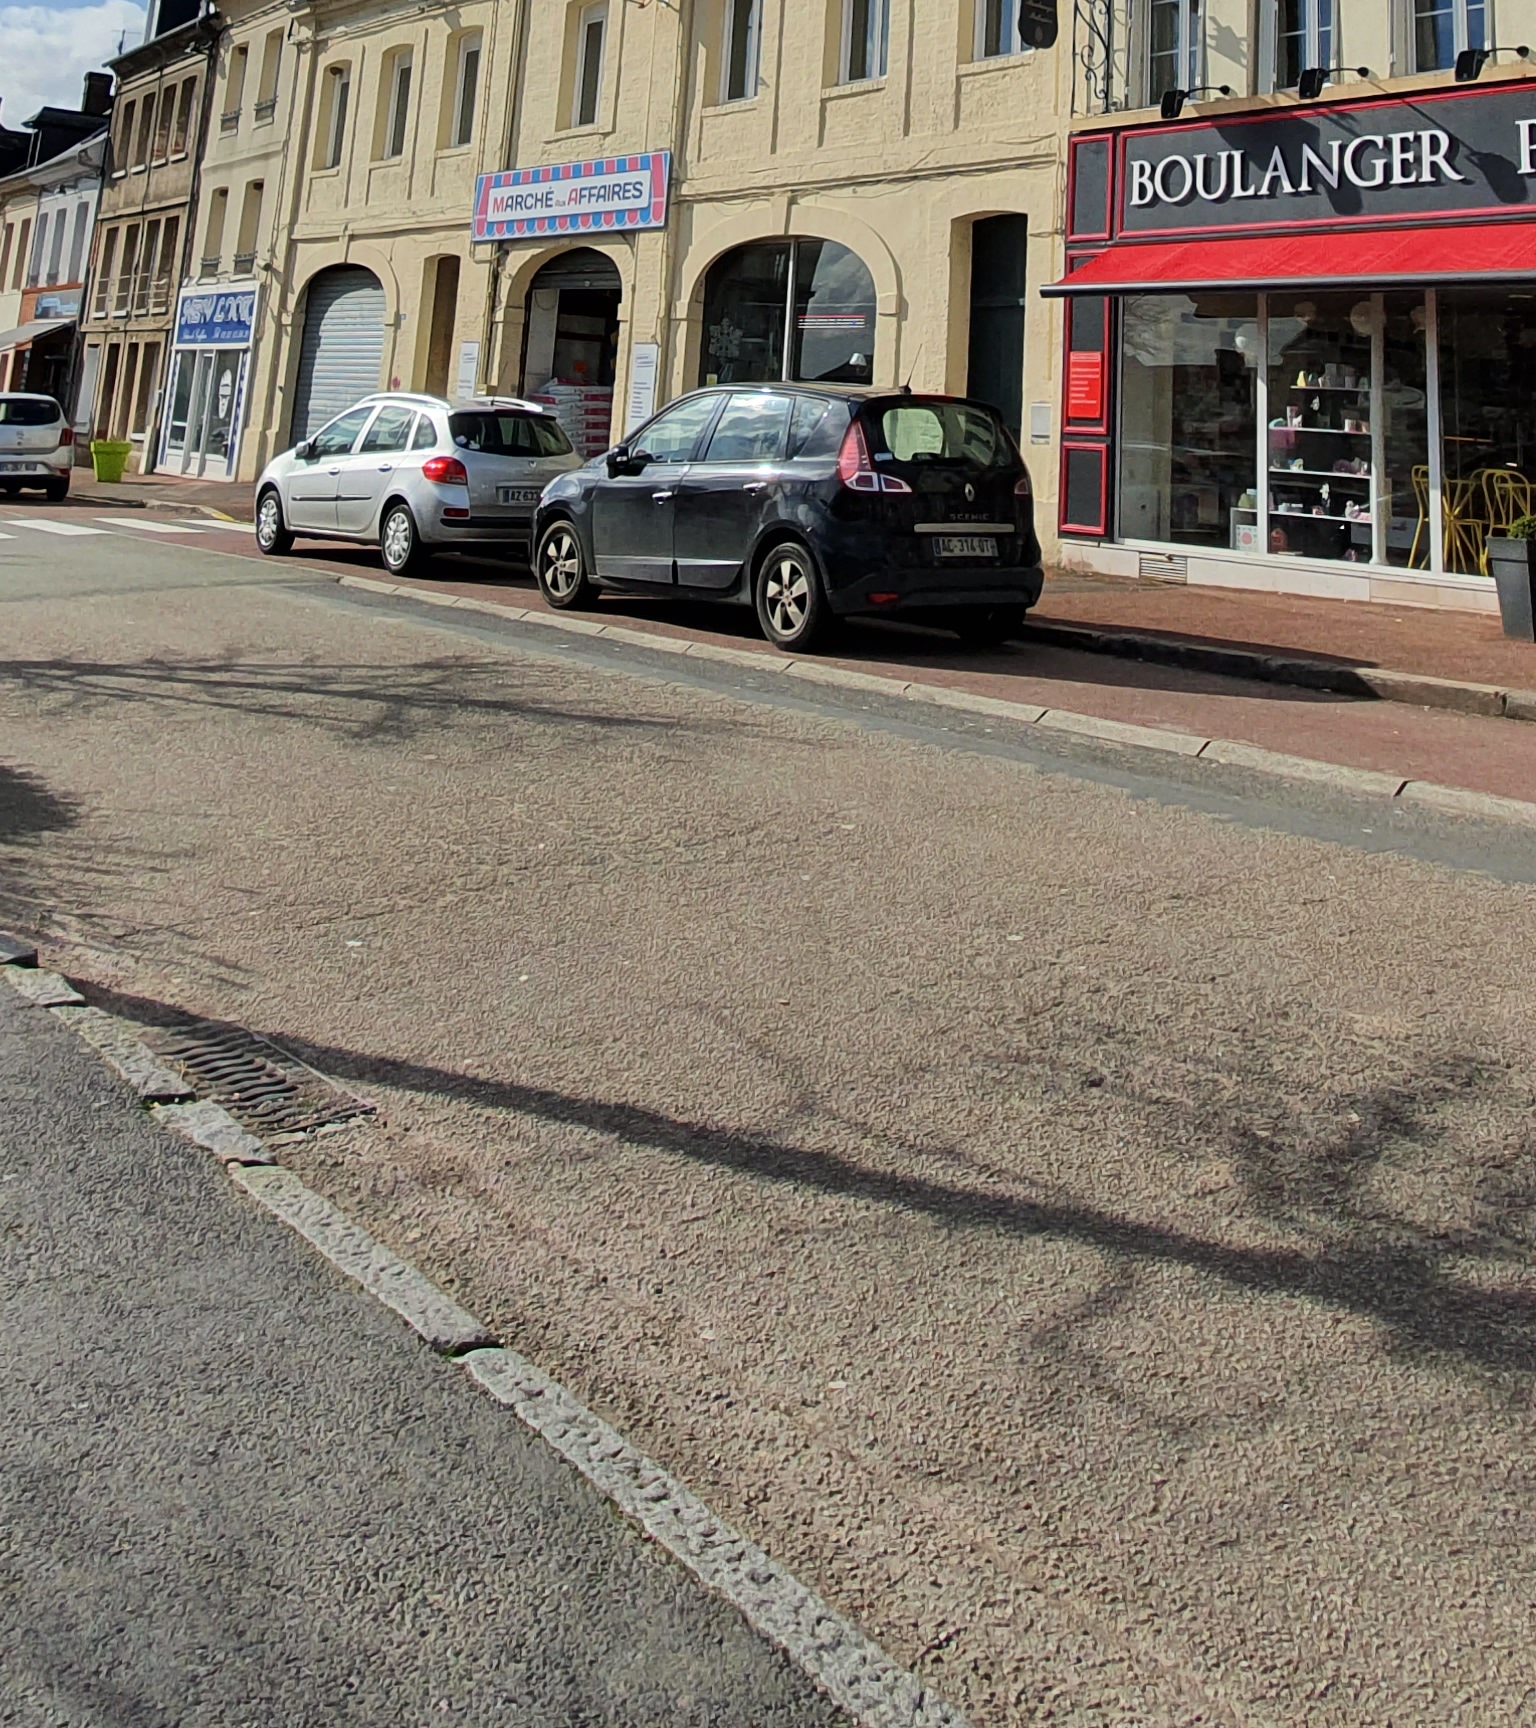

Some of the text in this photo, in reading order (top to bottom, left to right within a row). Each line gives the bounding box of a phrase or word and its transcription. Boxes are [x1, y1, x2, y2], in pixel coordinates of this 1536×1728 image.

[1129, 129, 1465, 208] BOULANGER
[492, 186, 555, 214] MARCHÉ
[567, 180, 644, 206] AFFAIRES
